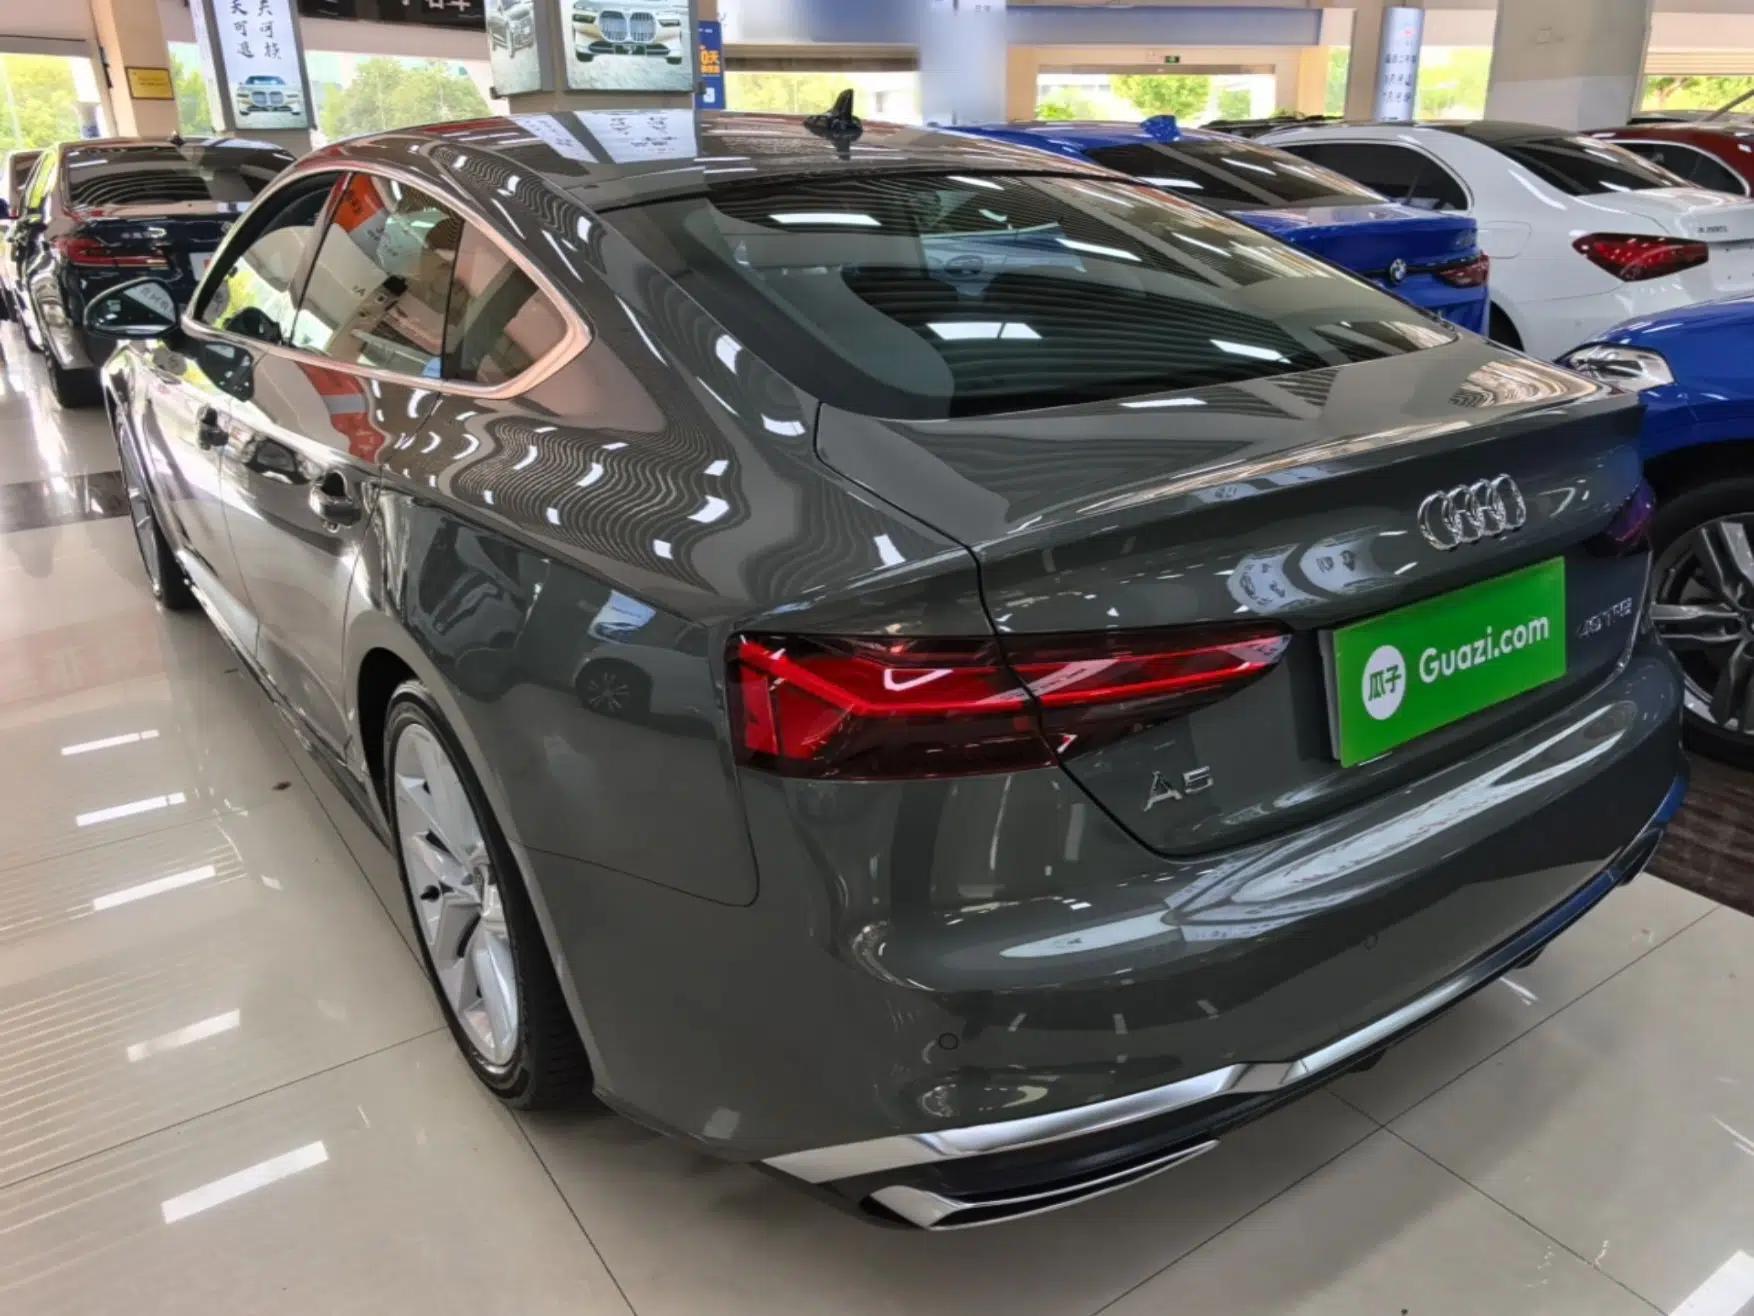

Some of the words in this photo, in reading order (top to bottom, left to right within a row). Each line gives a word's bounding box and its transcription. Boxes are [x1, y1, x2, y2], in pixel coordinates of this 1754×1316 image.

[1418, 616, 1550, 684] Guazi.com
[1367, 664, 1402, 702] 瓜子
[1143, 765, 1214, 812] A5
